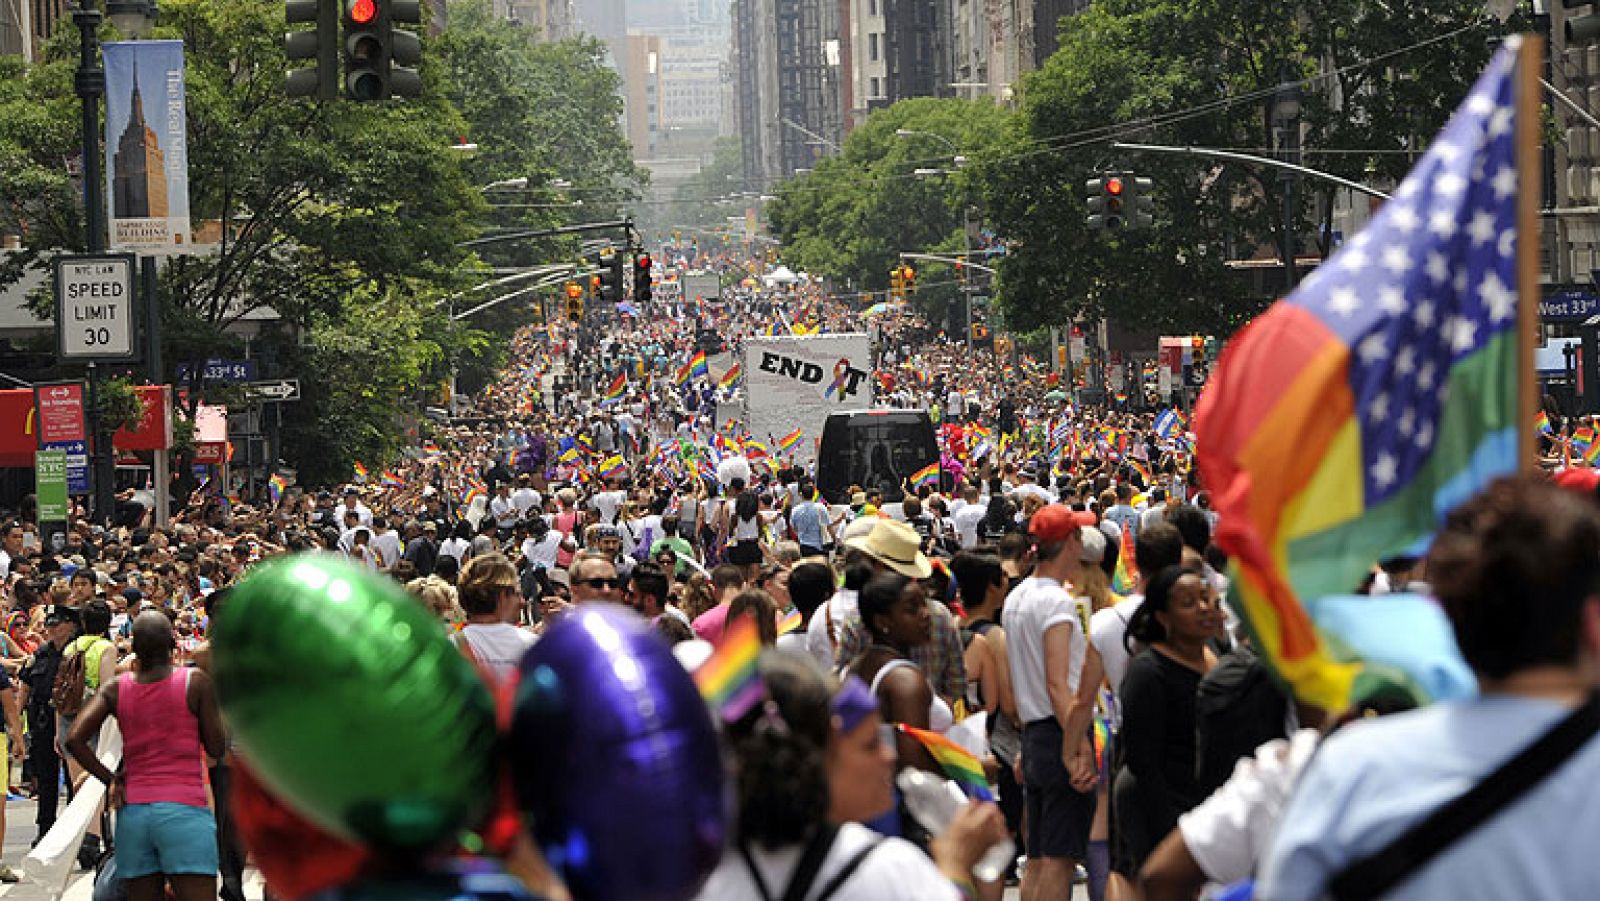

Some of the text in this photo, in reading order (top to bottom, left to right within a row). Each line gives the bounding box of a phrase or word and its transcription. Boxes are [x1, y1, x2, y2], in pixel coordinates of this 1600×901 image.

[168, 101, 182, 135] Real
[75, 266, 114, 275] NYC LAW
[68, 282, 124, 299] SPEED
[74, 304, 117, 321] LIMIT
[84, 327, 109, 346] 30
[232, 365, 247, 378] St
[760, 352, 824, 383] END
